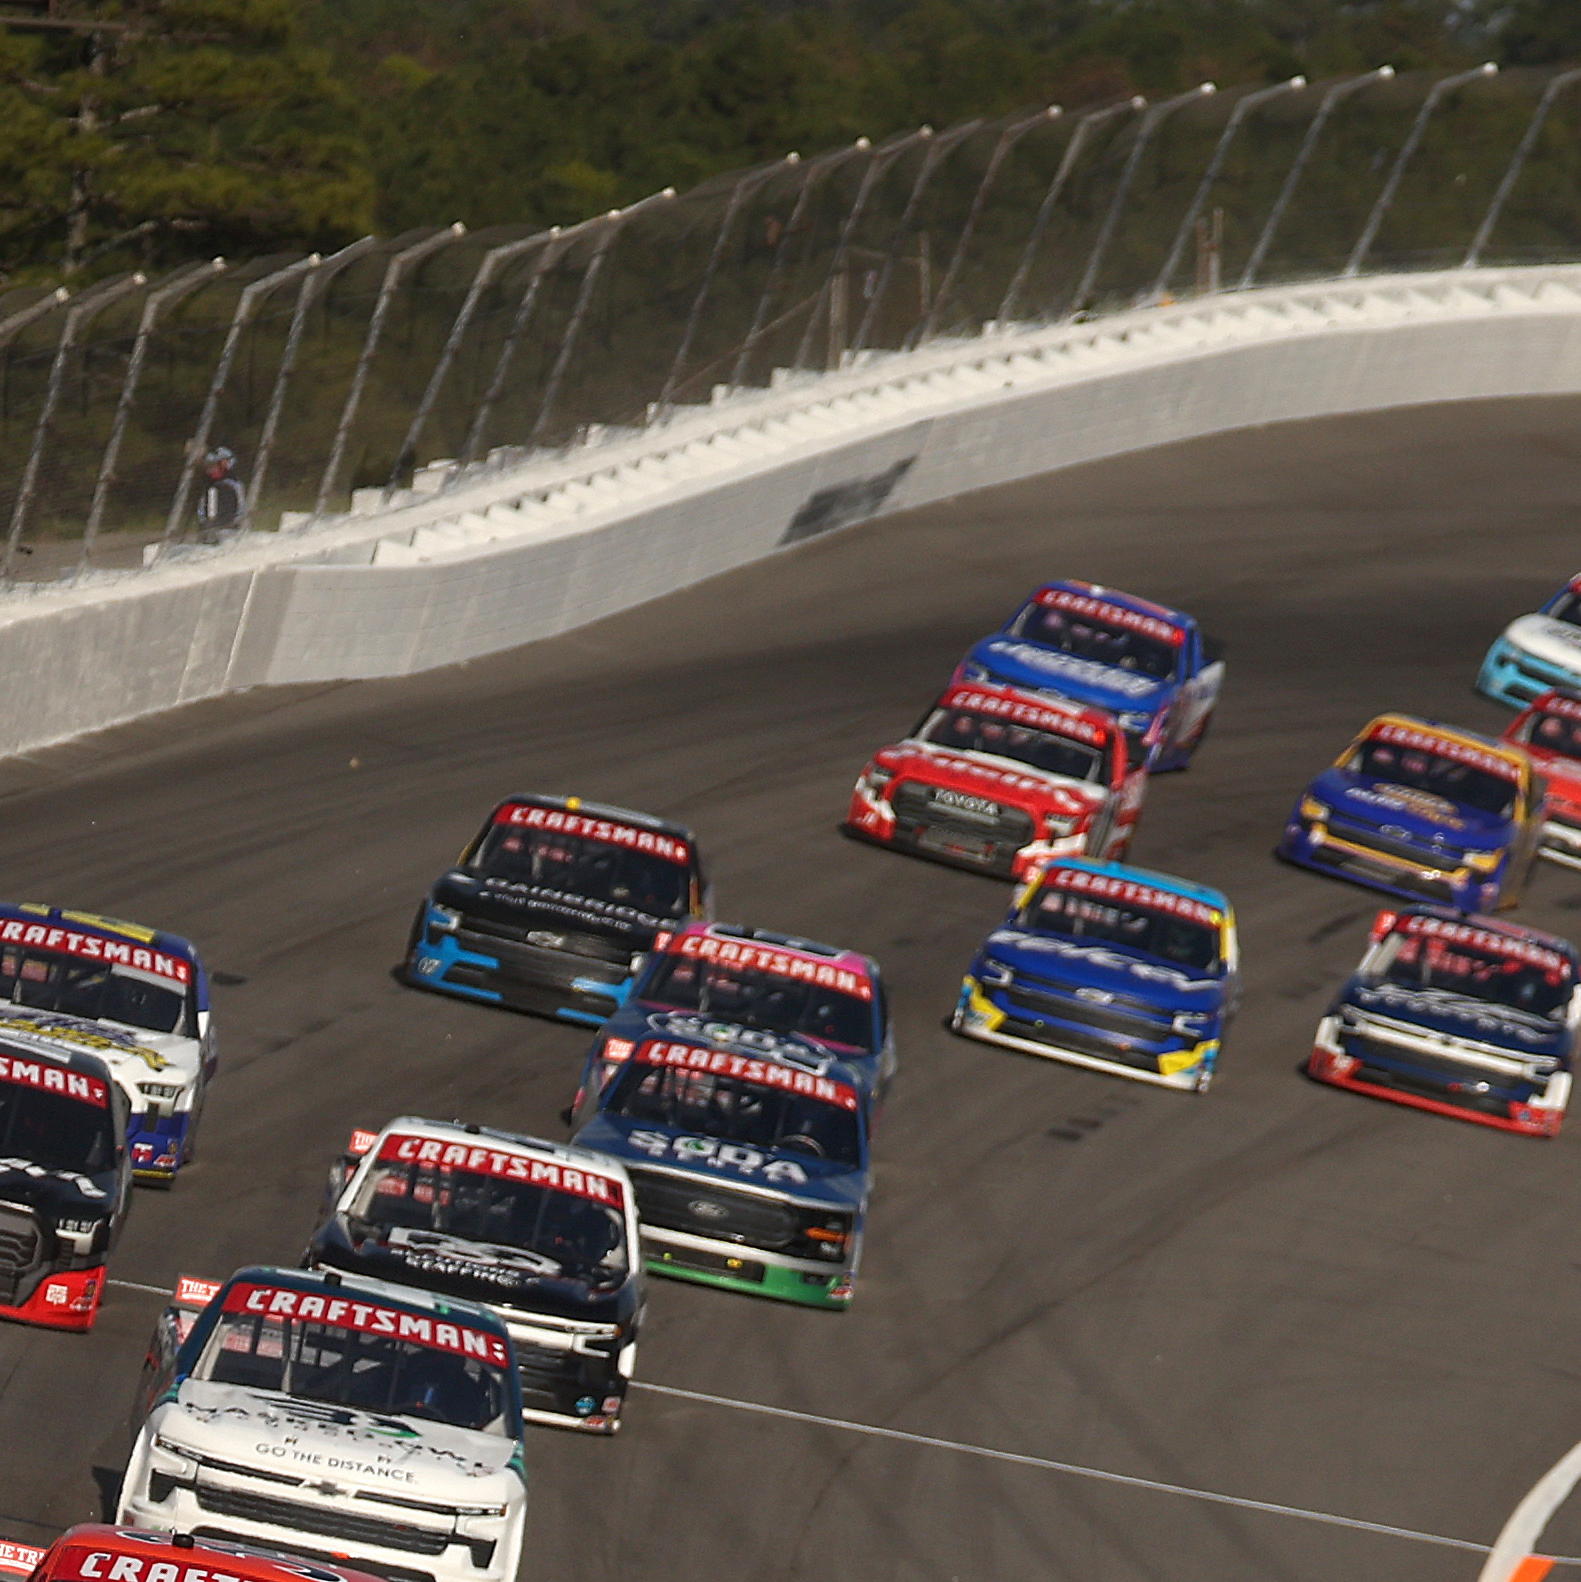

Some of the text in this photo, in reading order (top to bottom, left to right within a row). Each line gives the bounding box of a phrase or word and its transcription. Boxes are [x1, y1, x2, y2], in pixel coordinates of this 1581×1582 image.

[510, 807, 675, 857] CRAFTSMAN
[682, 936, 857, 990] CRAFTSMAN
[648, 1041, 838, 1099] CRAFTSMAN
[398, 1139, 608, 1199] CRAFTSMAN
[245, 1288, 488, 1357] CRAFTSMAN
[255, 1442, 416, 1483] GO THE DISTANCE
